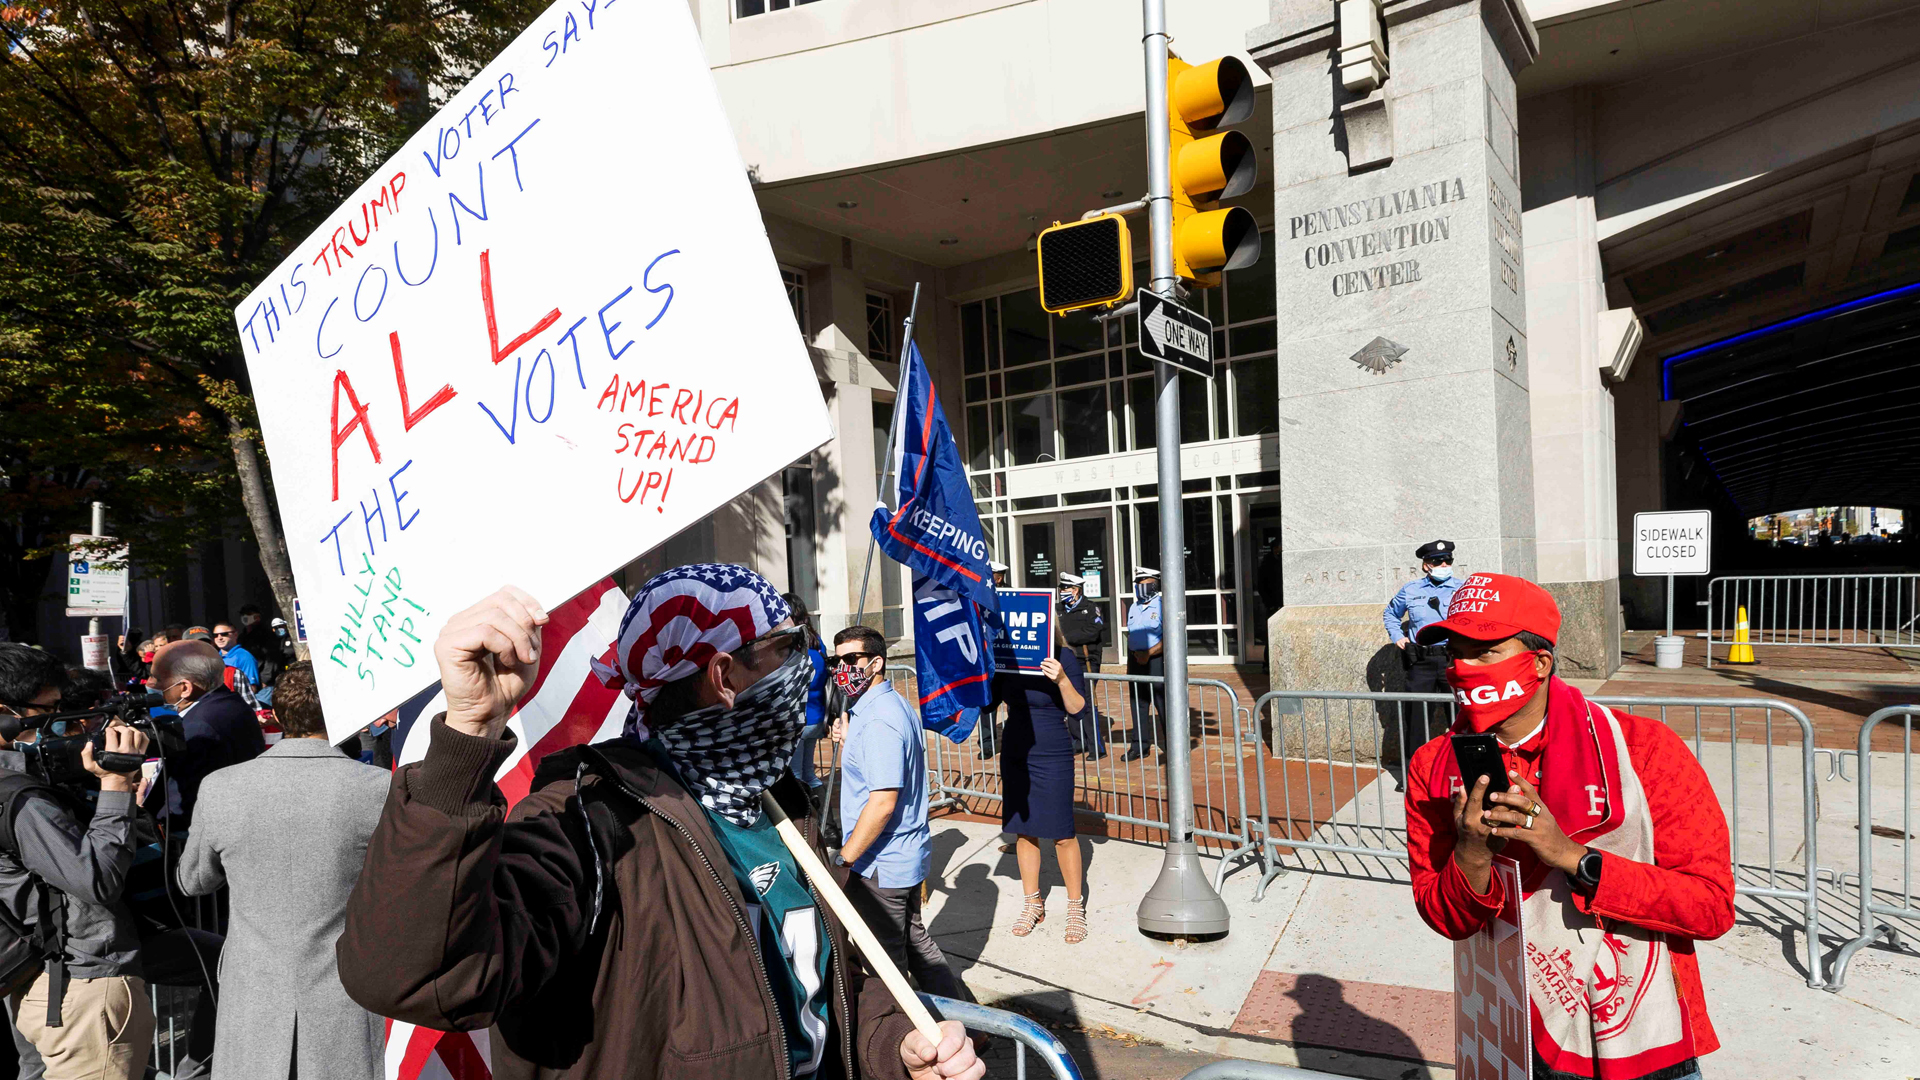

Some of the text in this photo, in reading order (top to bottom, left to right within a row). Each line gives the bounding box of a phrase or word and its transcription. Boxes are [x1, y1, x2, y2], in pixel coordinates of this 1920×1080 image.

[242, 0, 617, 353] THIS TRUMP VOTER SAY
[1290, 177, 1467, 239] PENNSYLVANIA
[317, 118, 541, 359] COUNT
[1305, 216, 1451, 269] CONVENTION
[1332, 259, 1422, 297] CENTER
[1165, 319, 1208, 357] ONE WAY
[331, 249, 561, 502] ALL
[320, 249, 681, 576] THE VOTES
[597, 373, 739, 433] AMERICA
[615, 423, 716, 464] STAND
[617, 467, 674, 514] UP!
[1055, 464, 1115, 484] WEST
[909, 505, 985, 560] KEEPING
[1640, 527, 1703, 542] SIDEWALK
[1646, 545, 1697, 558] CLOSED
[1377, 564, 1468, 580] STRT
[1464, 575, 1492, 586] EEP
[330, 553, 376, 669] PHILLY
[357, 566, 403, 690] STAND
[393, 598, 431, 668] UP!
[913, 570, 978, 665] MP
[996, 629, 1037, 641] NCE
[1001, 611, 1046, 627] MP
[1452, 680, 1525, 705] AGA
